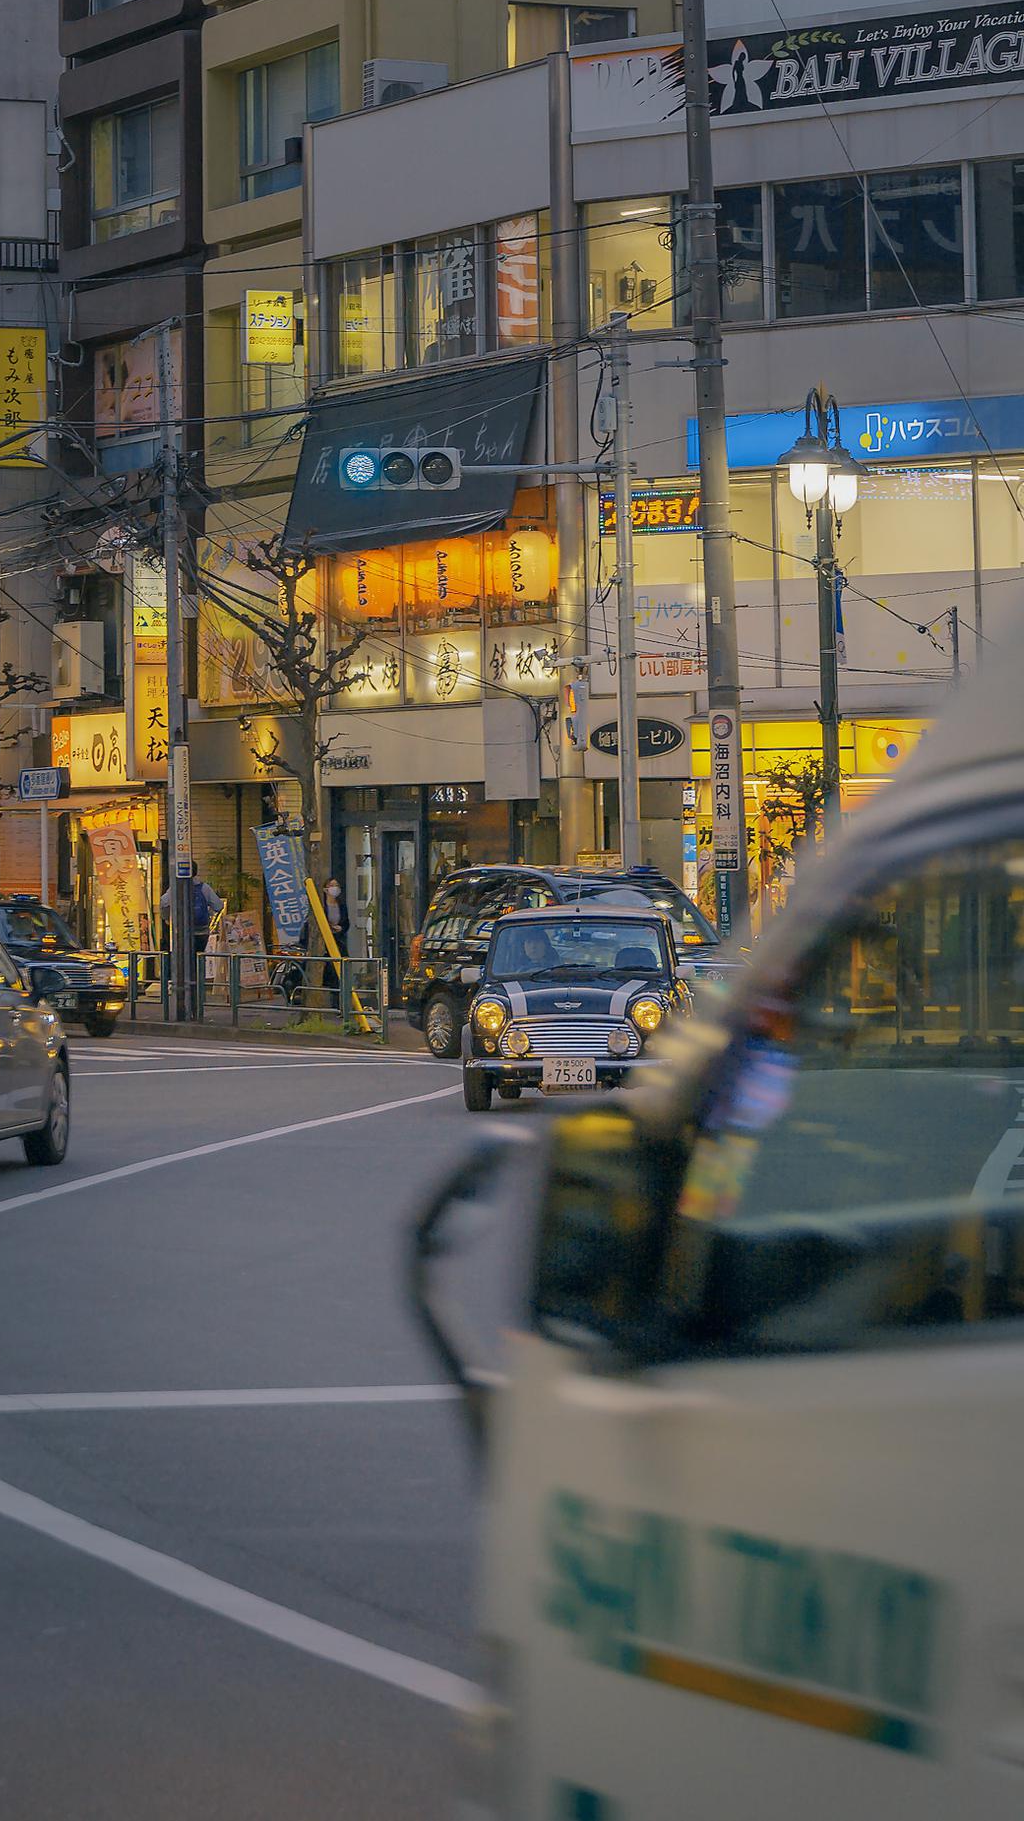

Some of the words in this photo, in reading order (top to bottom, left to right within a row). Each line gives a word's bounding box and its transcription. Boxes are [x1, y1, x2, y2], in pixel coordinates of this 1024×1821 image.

[855, 29, 889, 43] Let's
[894, 24, 934, 40] Enjoy
[936, 17, 970, 33] Your
[770, 49, 865, 100] BALI
[249, 313, 290, 327] ステーション
[3, 348, 22, 429] もみ次郎
[889, 418, 981, 442] ハウスコム
[91, 724, 127, 775] 日高
[713, 742, 732, 820] 海沼内科
[555, 1069, 593, 1082] 75-60
